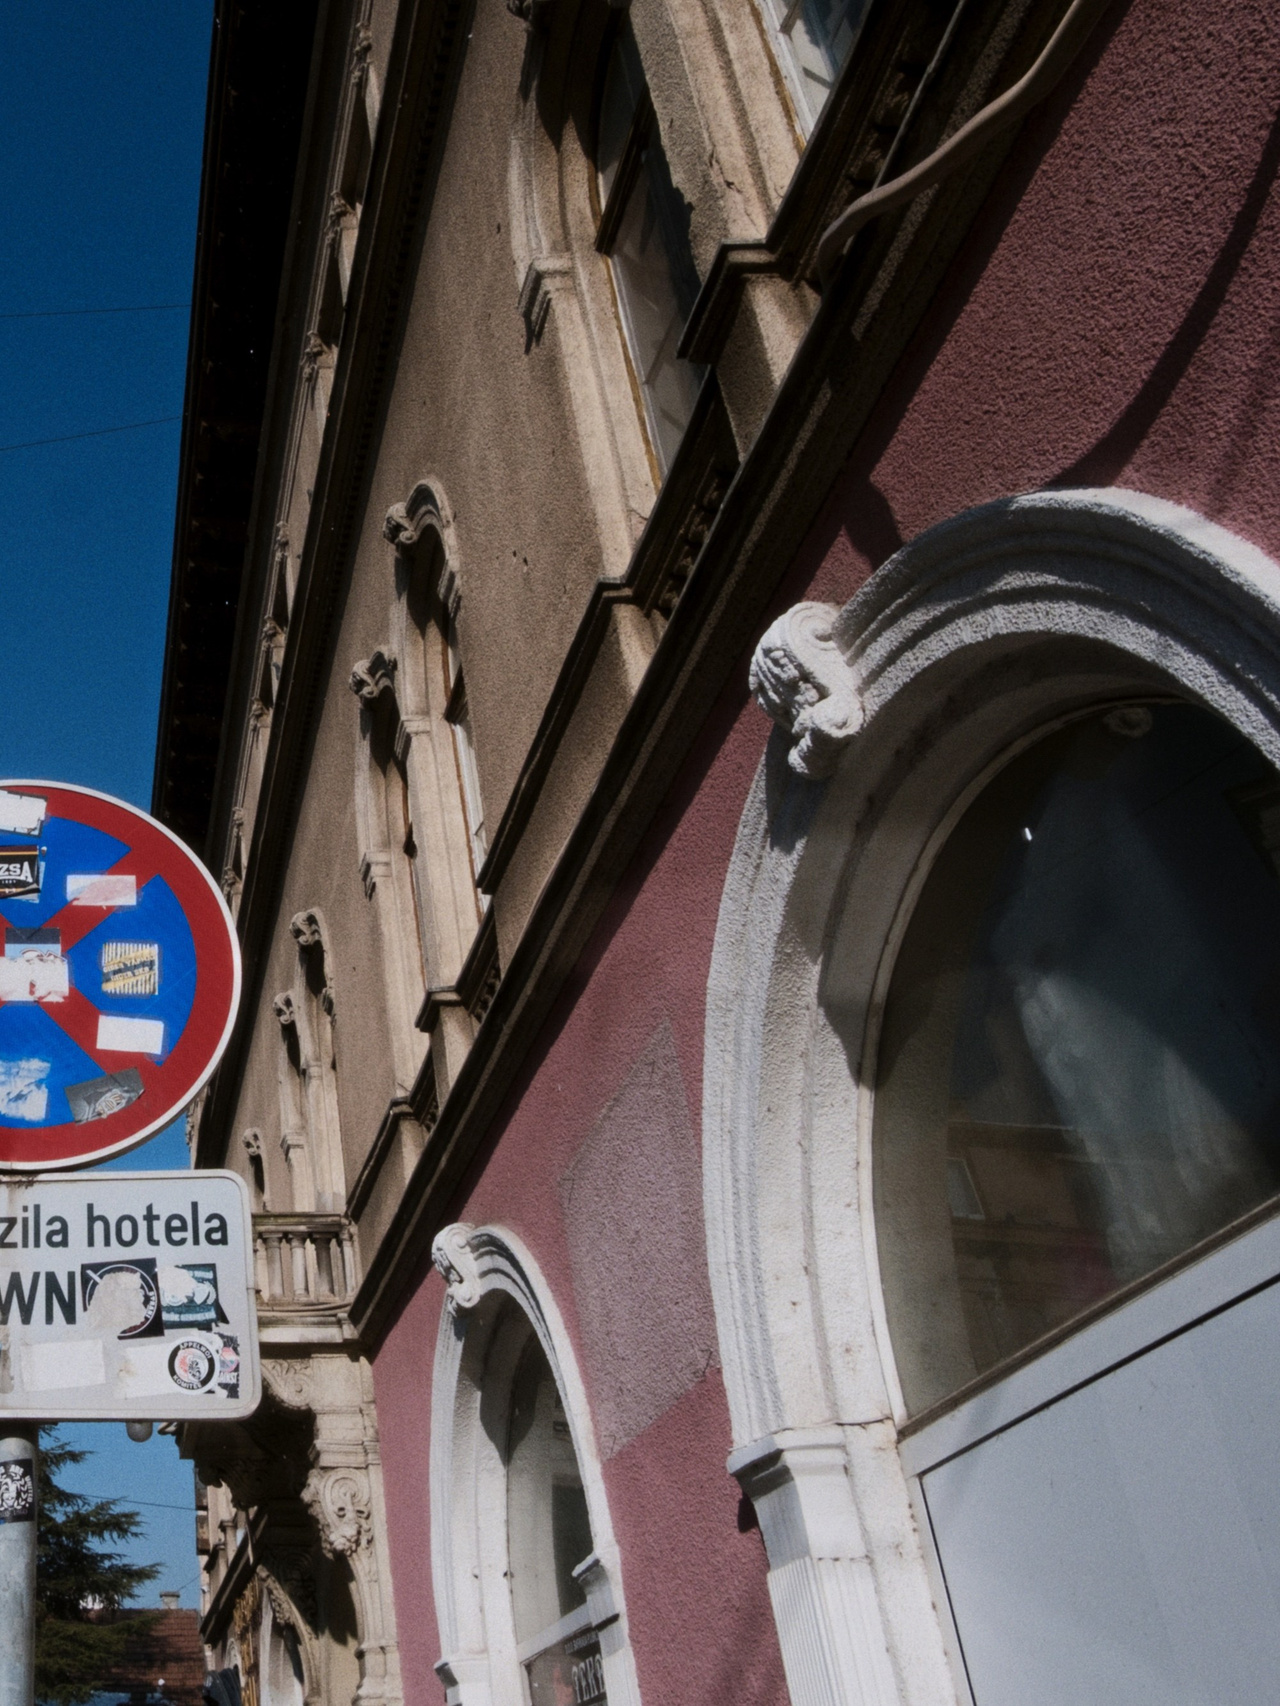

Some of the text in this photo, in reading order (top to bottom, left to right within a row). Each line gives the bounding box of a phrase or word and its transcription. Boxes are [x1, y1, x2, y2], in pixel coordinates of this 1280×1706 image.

[87, 1201, 229, 1248] hotela
[9, 1464, 24, 1476] ARE
[24, 1475, 33, 1503] UNITED
